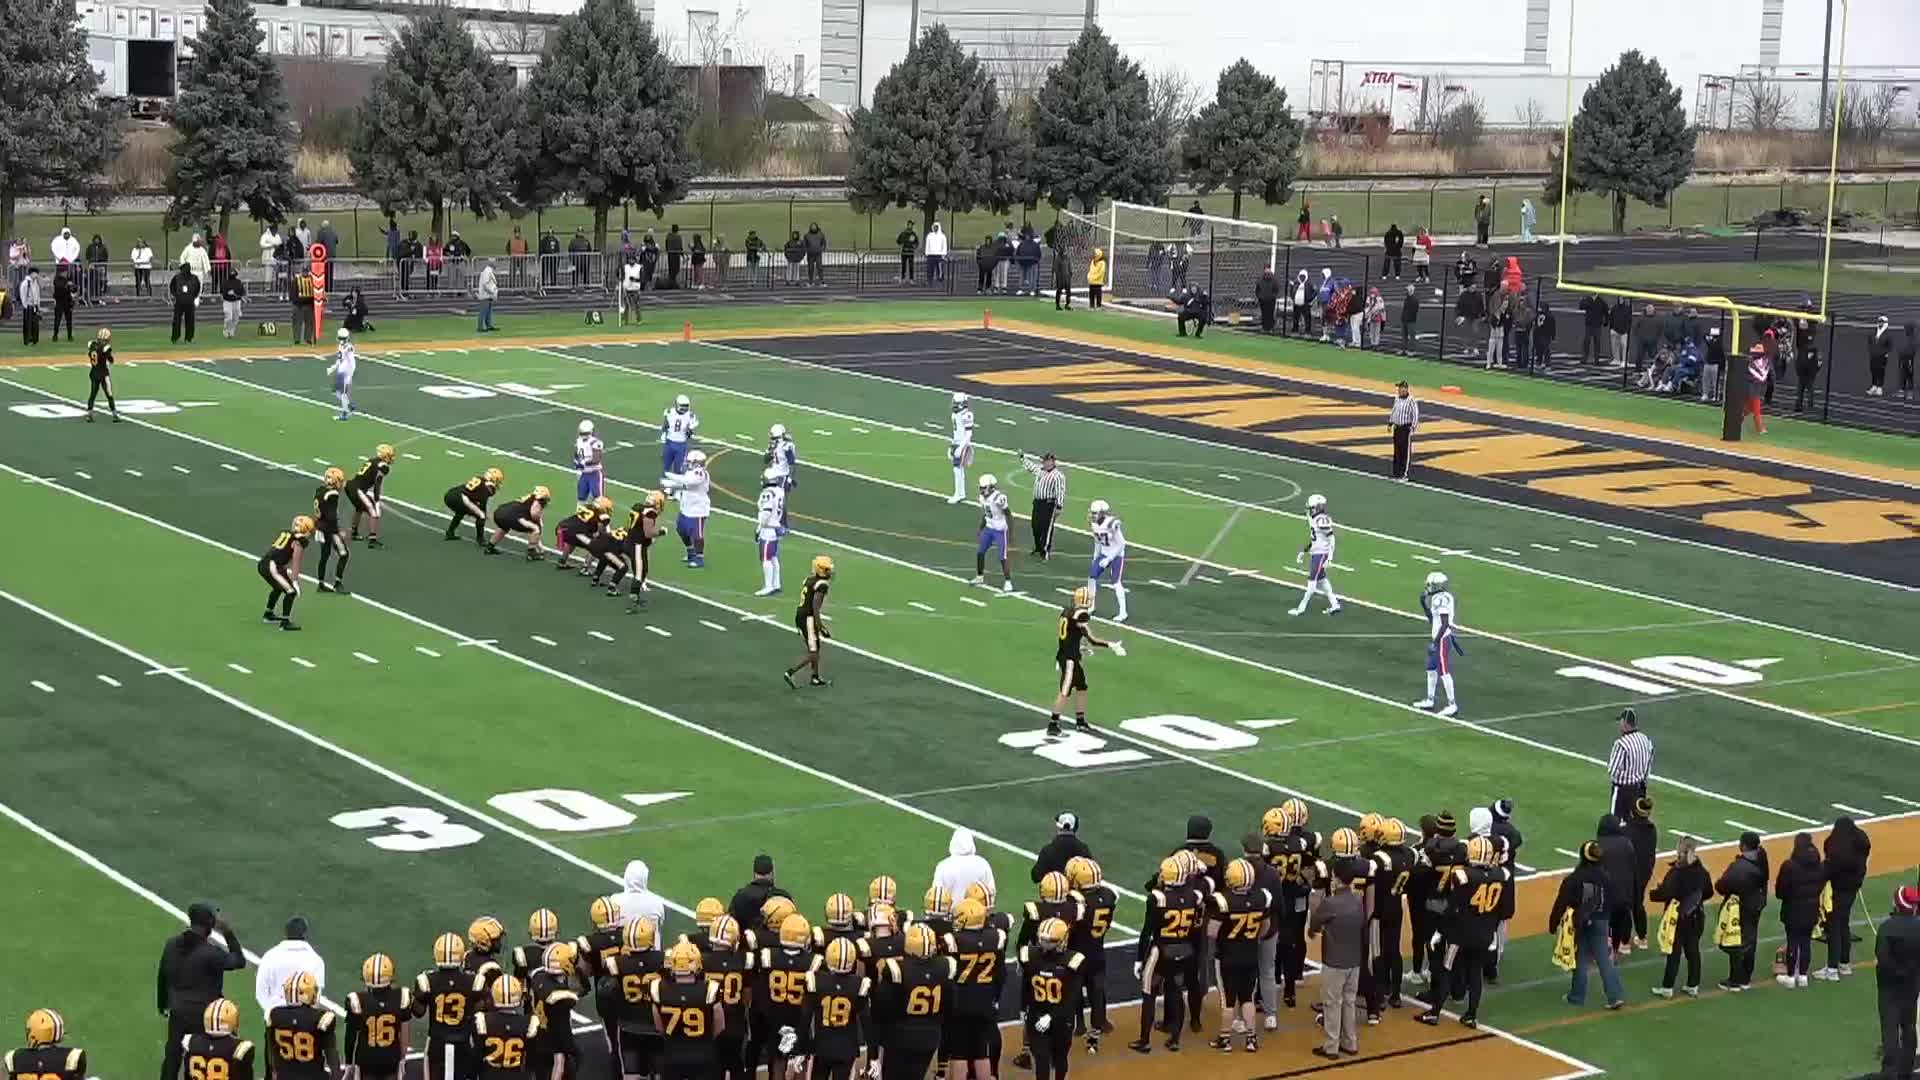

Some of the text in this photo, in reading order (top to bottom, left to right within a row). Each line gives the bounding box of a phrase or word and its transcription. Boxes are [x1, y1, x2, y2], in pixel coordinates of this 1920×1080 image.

[1360, 71, 1394, 87] XTRA
[262, 321, 275, 335] 10
[1555, 655, 1764, 694] 10
[998, 715, 1260, 768] 20
[329, 787, 638, 851] 30
[1470, 882, 1502, 914] 40
[1091, 908, 1109, 937] 5
[1160, 907, 1195, 938] 25
[1228, 911, 1263, 939] 75
[957, 952, 996, 984] 72
[769, 970, 807, 1005] 85
[906, 984, 942, 1016] 61
[434, 993, 466, 1025] 13
[660, 1007, 705, 1037] 79
[820, 995, 851, 1027] 18
[274, 1029, 315, 1062] 58
[365, 1014, 396, 1047] 16
[483, 1037, 525, 1068] 26
